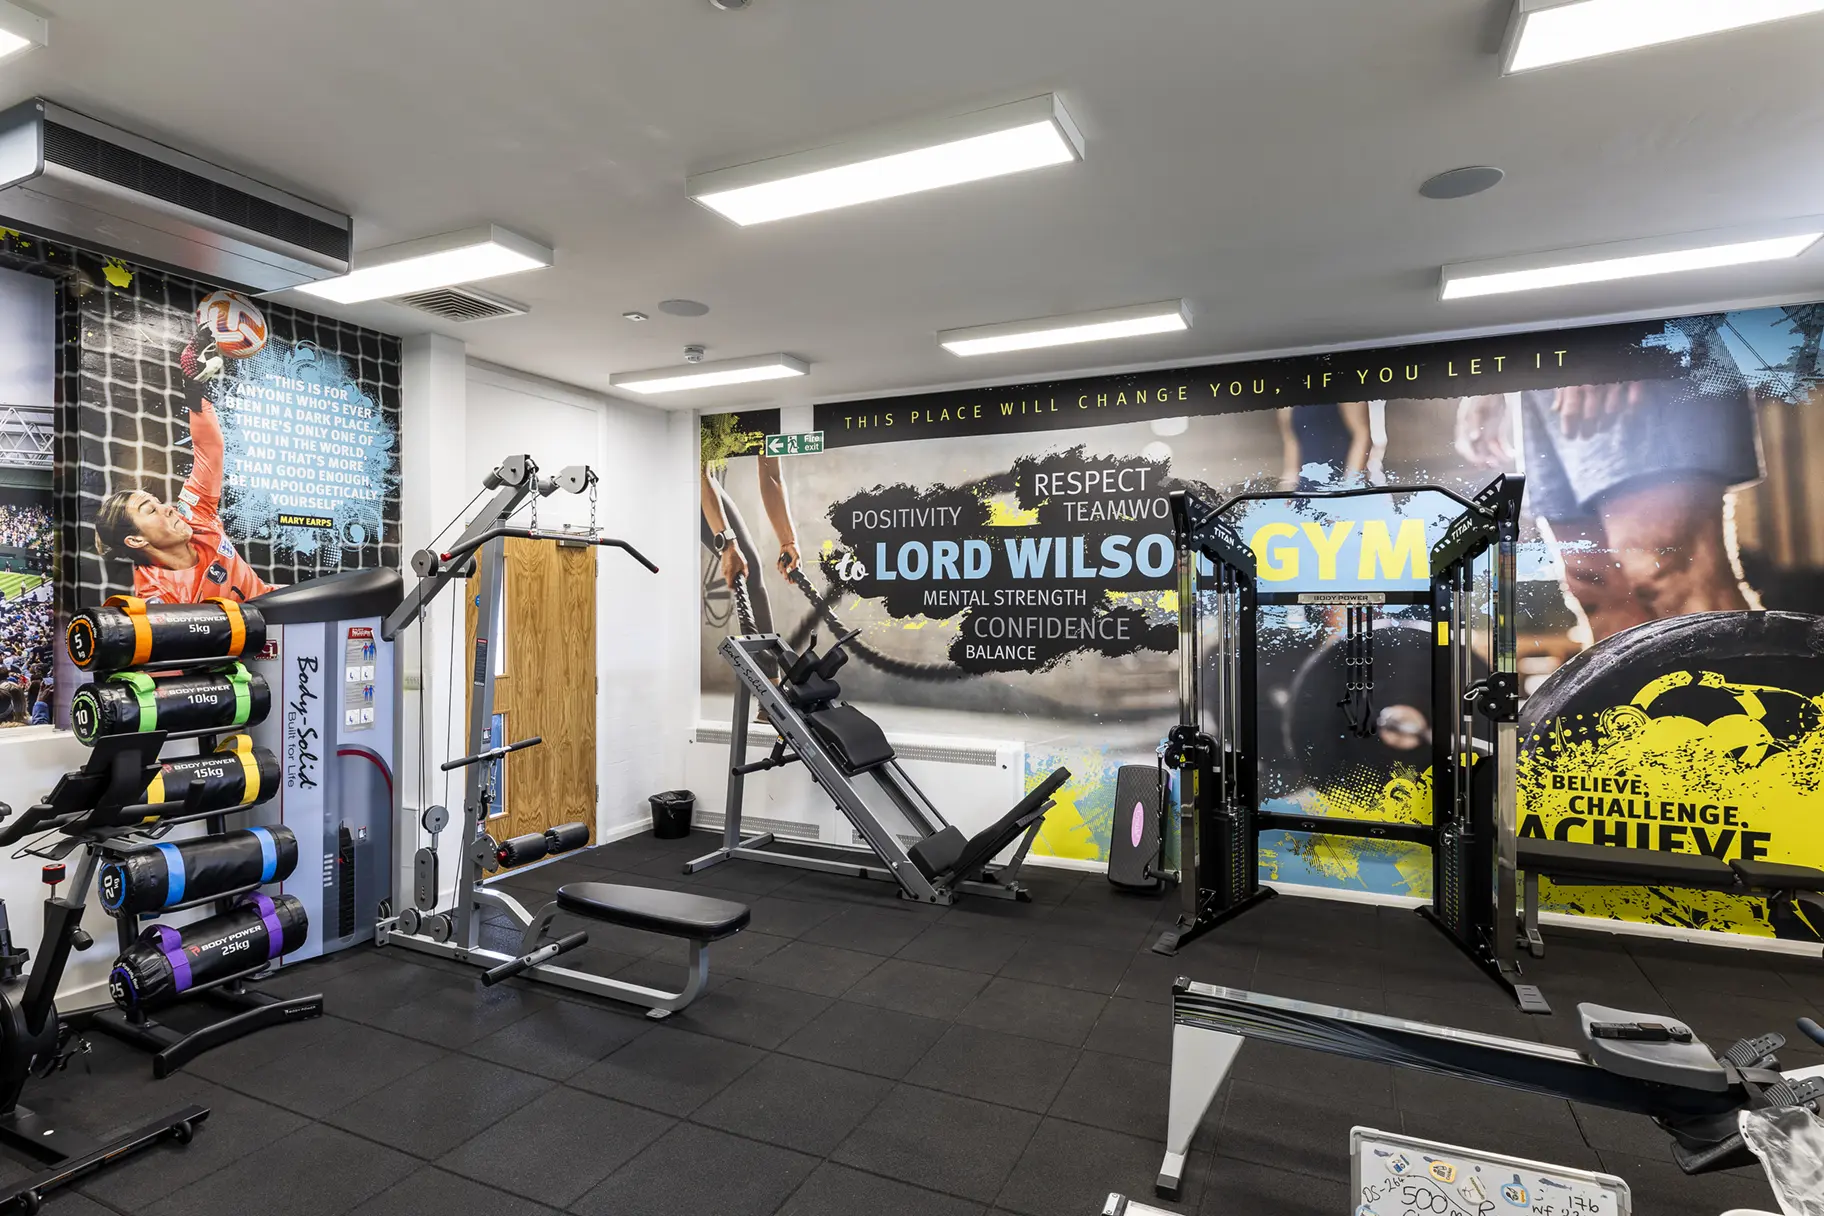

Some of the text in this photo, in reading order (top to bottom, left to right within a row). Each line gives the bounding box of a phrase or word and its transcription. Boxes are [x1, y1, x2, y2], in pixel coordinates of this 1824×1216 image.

[236, 383, 372, 419] ANYONE WHO'S EVER
[308, 382, 320, 396] IS
[324, 386, 348, 401] FOR
[844, 350, 1567, 430] THIS PLACE WILL CHANGE YOU, IF YOU LET IT
[226, 396, 380, 434] BEEN IN A DARK PLACE...
[234, 413, 374, 446] THERE'S ONLY ONE OF
[804, 434, 820, 442] Fire
[241, 429, 368, 461] YOU IN THE WORLD,
[804, 442, 819, 451] exit
[247, 446, 364, 472] AND THAT'S MORE
[234, 459, 373, 488] THAN GOOD ENOUGH,
[1034, 467, 1152, 497] RESPECT
[230, 474, 378, 500] BE UNAPOLOGETICALLY
[280, 516, 332, 527] MARY EARPS
[852, 506, 962, 530] POSITIVITY
[1064, 498, 1170, 522] TEAMWO
[1214, 526, 1234, 546] TITAN
[1451, 518, 1472, 540] TITAN
[835, 553, 869, 583] to
[876, 540, 993, 581] LORD
[1250, 518, 1430, 582] GYM
[924, 588, 1087, 607] MENTAL STRENGTH
[189, 624, 210, 634] 5kg
[974, 616, 1131, 640] CONFIDENCE
[74, 633, 82, 650] 5
[966, 644, 1036, 661] BALANCE
[722, 642, 768, 697] Body-Solid
[169, 684, 230, 696] BODY POWER
[188, 694, 218, 705] 10kg
[76, 710, 88, 726] 10
[290, 656, 318, 789] Body-Solid
[288, 711, 296, 788] Built for Life
[174, 757, 236, 771] BODY POWER
[194, 766, 224, 779] 15kg
[1552, 774, 1650, 798] BELIEVE,
[104, 874, 114, 900] 20
[114, 878, 120, 890] kg
[201, 924, 262, 952] BODY POWER
[221, 940, 250, 956] 25kg
[110, 982, 124, 998] 25
[1401, 1186, 1448, 1214] 500
